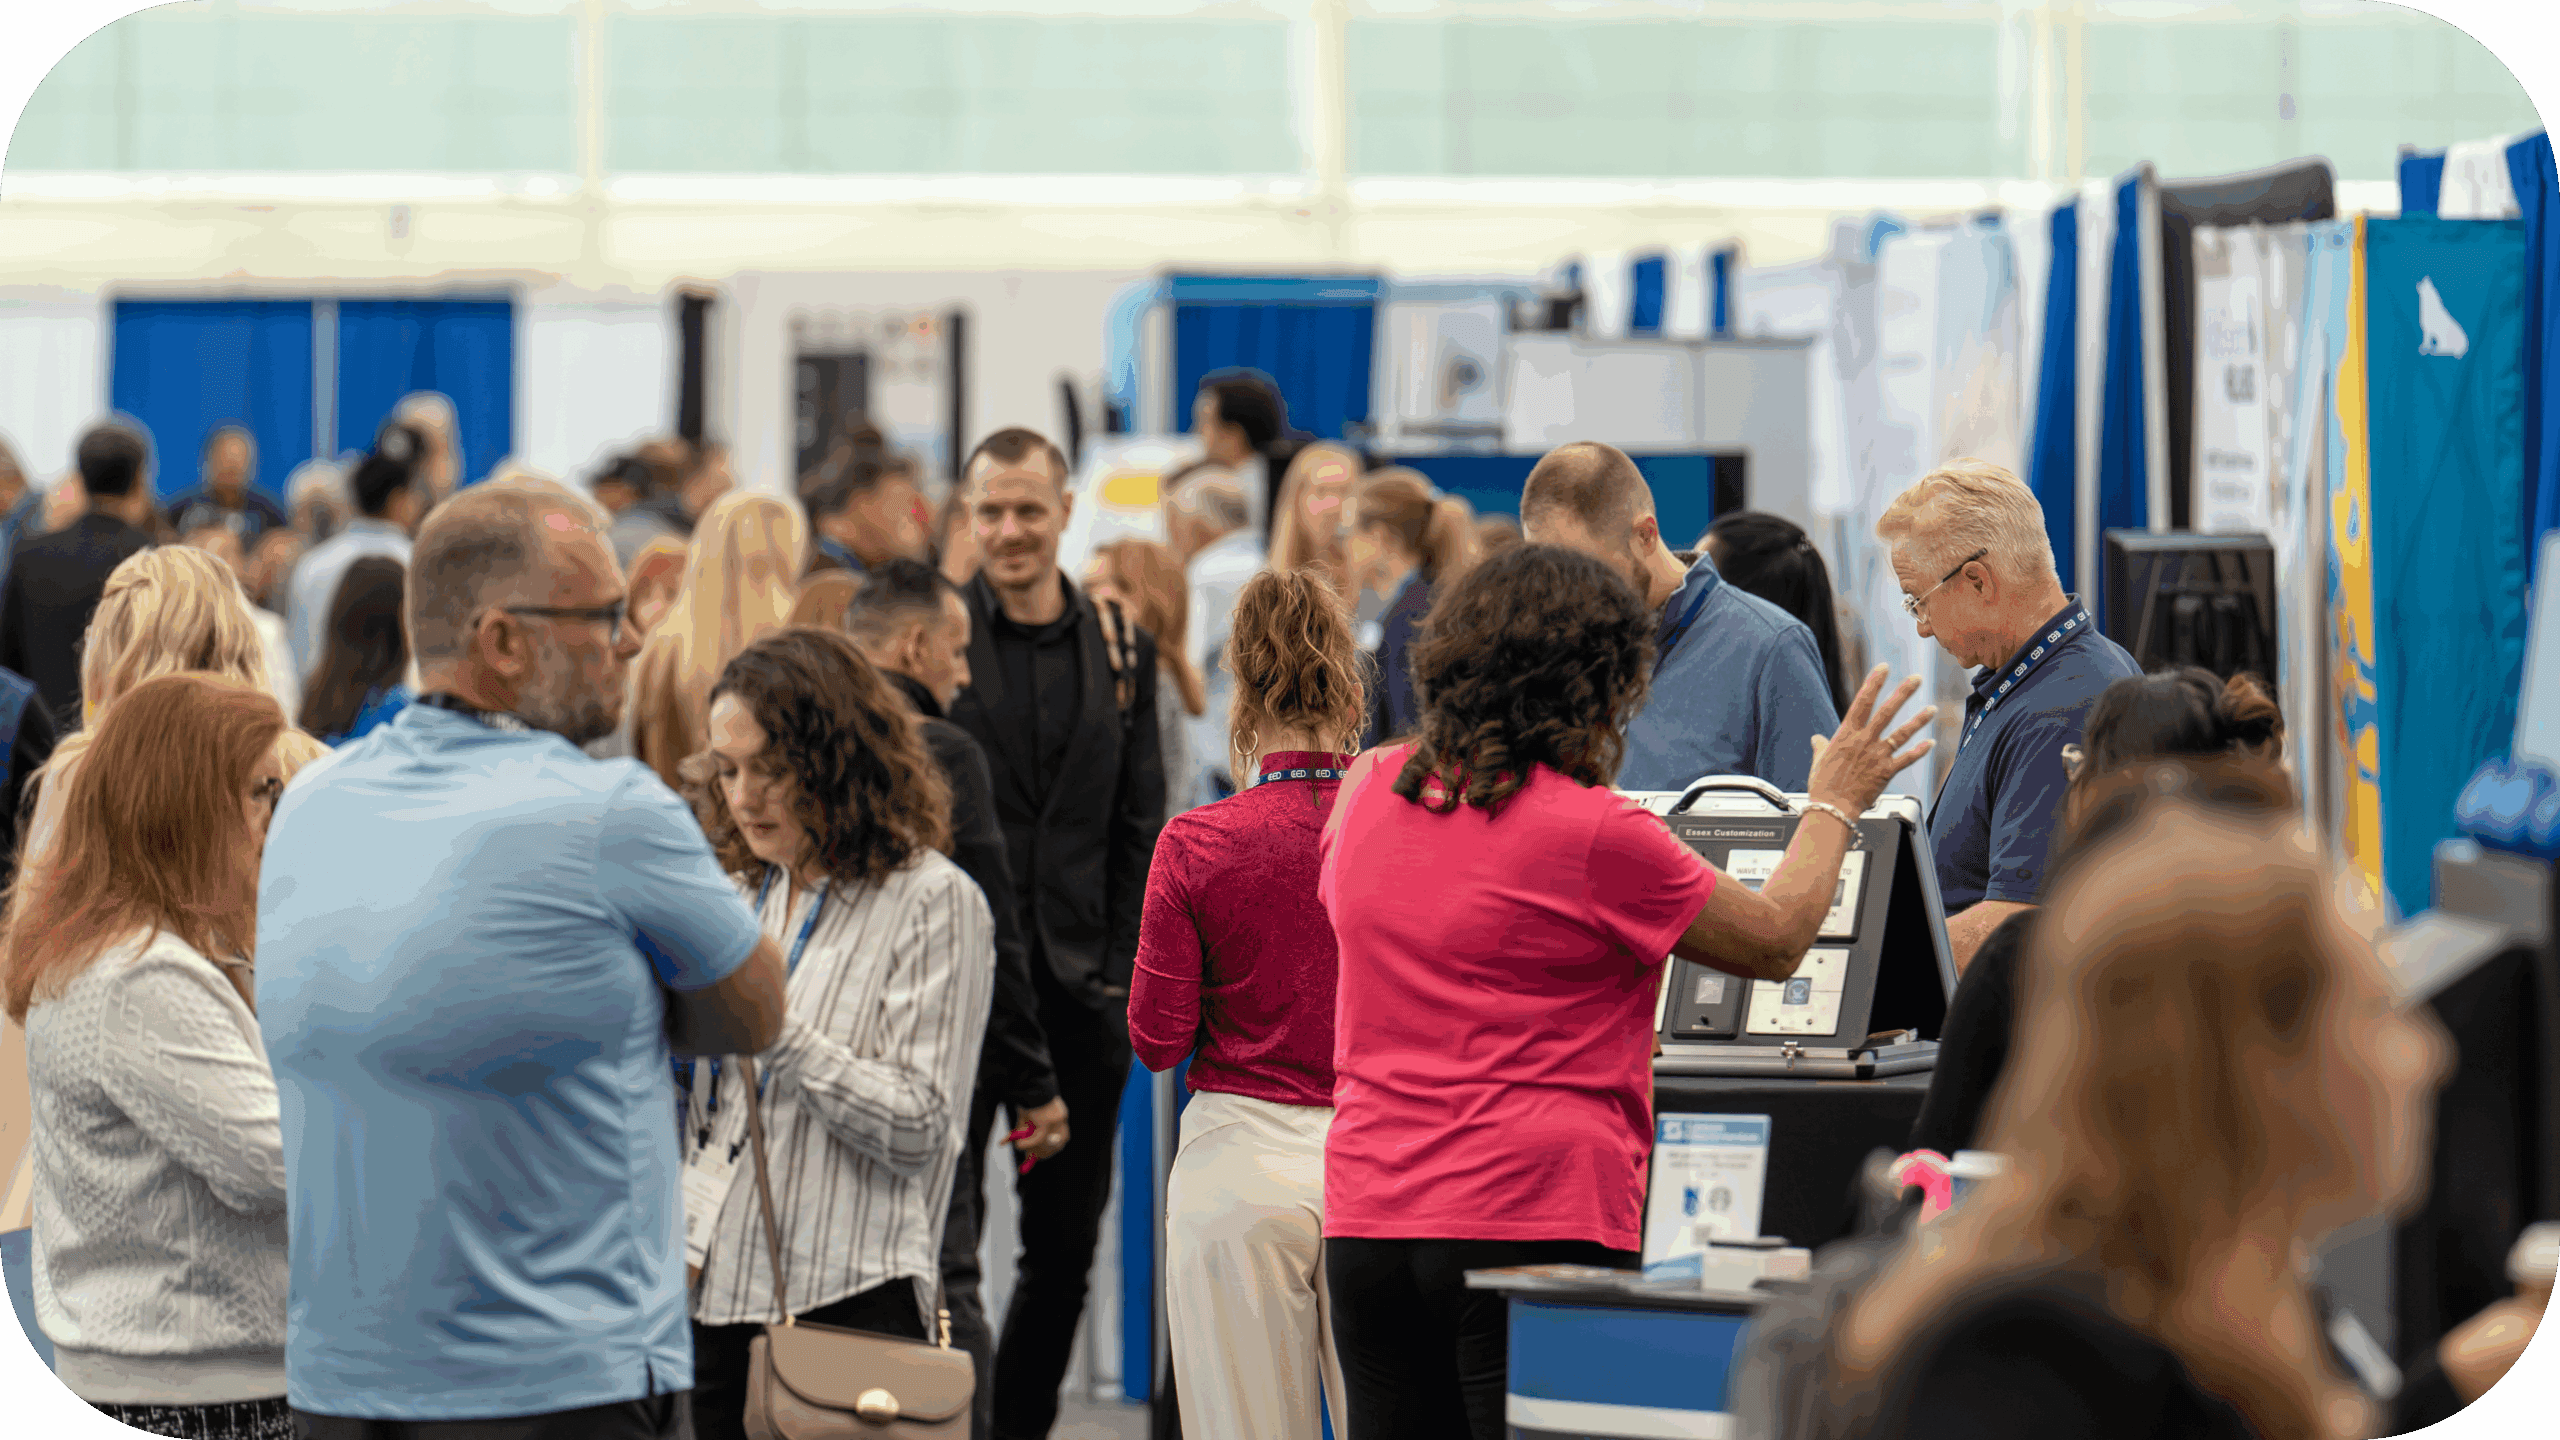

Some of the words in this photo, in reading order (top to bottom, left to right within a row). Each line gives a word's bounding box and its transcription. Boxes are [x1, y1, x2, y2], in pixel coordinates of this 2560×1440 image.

[1685, 828, 1711, 837] Essex
[1714, 828, 1775, 837] Customization
[1736, 867, 1757, 875] WAVE
[1761, 867, 1771, 875] TO
